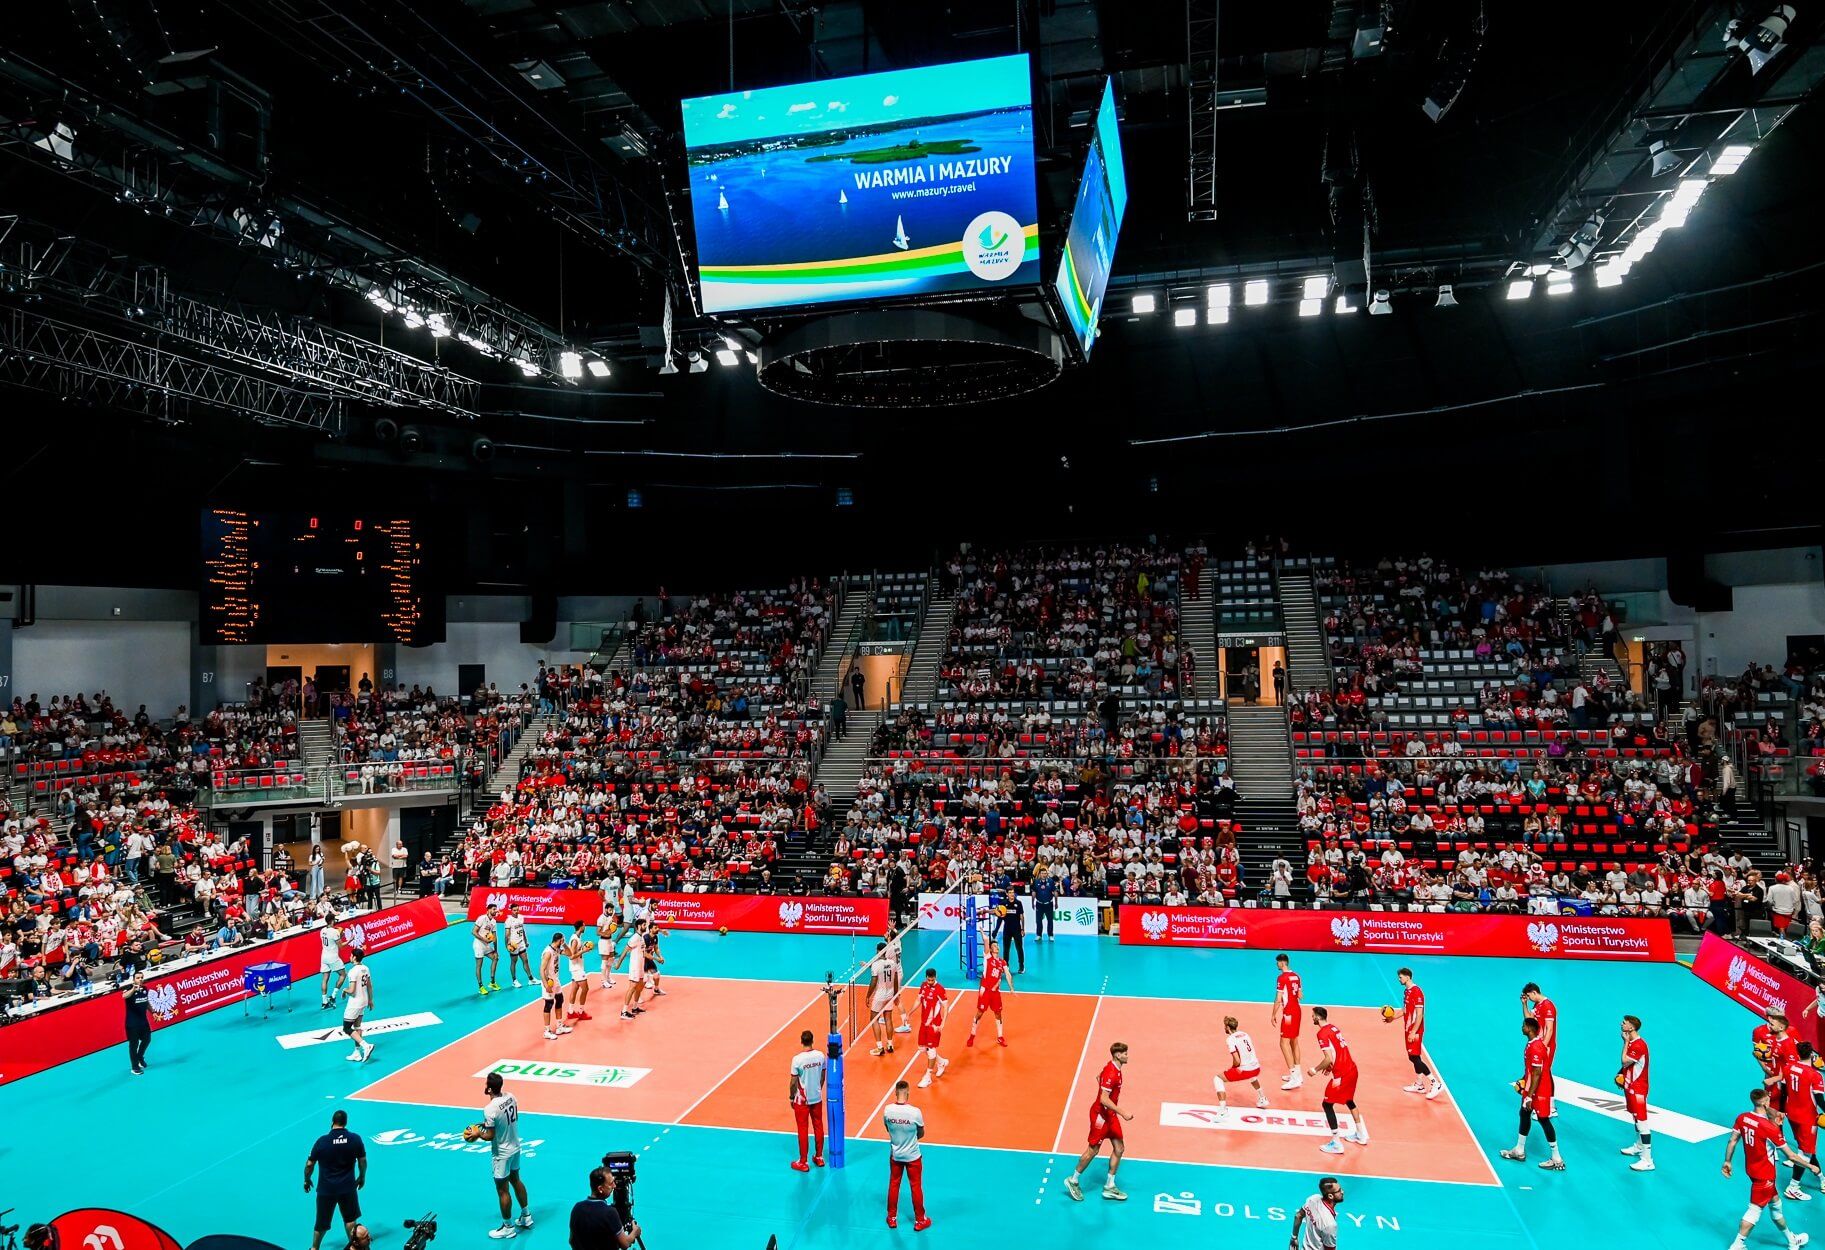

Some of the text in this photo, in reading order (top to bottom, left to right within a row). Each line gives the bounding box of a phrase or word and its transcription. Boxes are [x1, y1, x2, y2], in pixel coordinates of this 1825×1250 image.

[854, 156, 1012, 190] WARMIA I MAZURY
[892, 182, 976, 200] www.mazury.travel
[310, 518, 317, 528] 0
[354, 520, 362, 530] 0
[356, 551, 363, 560] 0
[202, 672, 214, 683] B7
[383, 669, 394, 679] B8
[510, 894, 553, 903] Ministerstwo
[535, 904, 566, 914] Turystyki
[805, 903, 854, 912] Ministerstwo
[682, 909, 715, 918] Turystyki
[804, 914, 829, 923] Sportu
[835, 914, 869, 924] Turystyki
[1053, 910, 1072, 921] us
[1171, 914, 1227, 924] Ministerstwo
[363, 914, 399, 931] Ministerstwo
[1362, 919, 1423, 930] Ministerstwo
[1171, 925, 1200, 934] Sportu
[1207, 926, 1246, 935] Turystyki
[1560, 925, 1625, 935] Ministerstwo
[1363, 930, 1394, 940] Sportu
[1401, 931, 1444, 942] Turystyki
[1562, 935, 1595, 946] Sportu
[1603, 937, 1648, 948] Turystyki
[176, 968, 230, 992] Ministerstwo
[883, 969, 892, 982] 14
[1746, 964, 1780, 991] Ministerstwo
[180, 989, 208, 1006] Sportu
[1243, 1039, 1252, 1052] 3
[493, 1063, 582, 1078] plus
[803, 1061, 822, 1070] POLSKA
[1790, 1073, 1799, 1092] 11
[1743, 1125, 1755, 1147] 16
[1214, 1202, 1402, 1231] OLSYN
